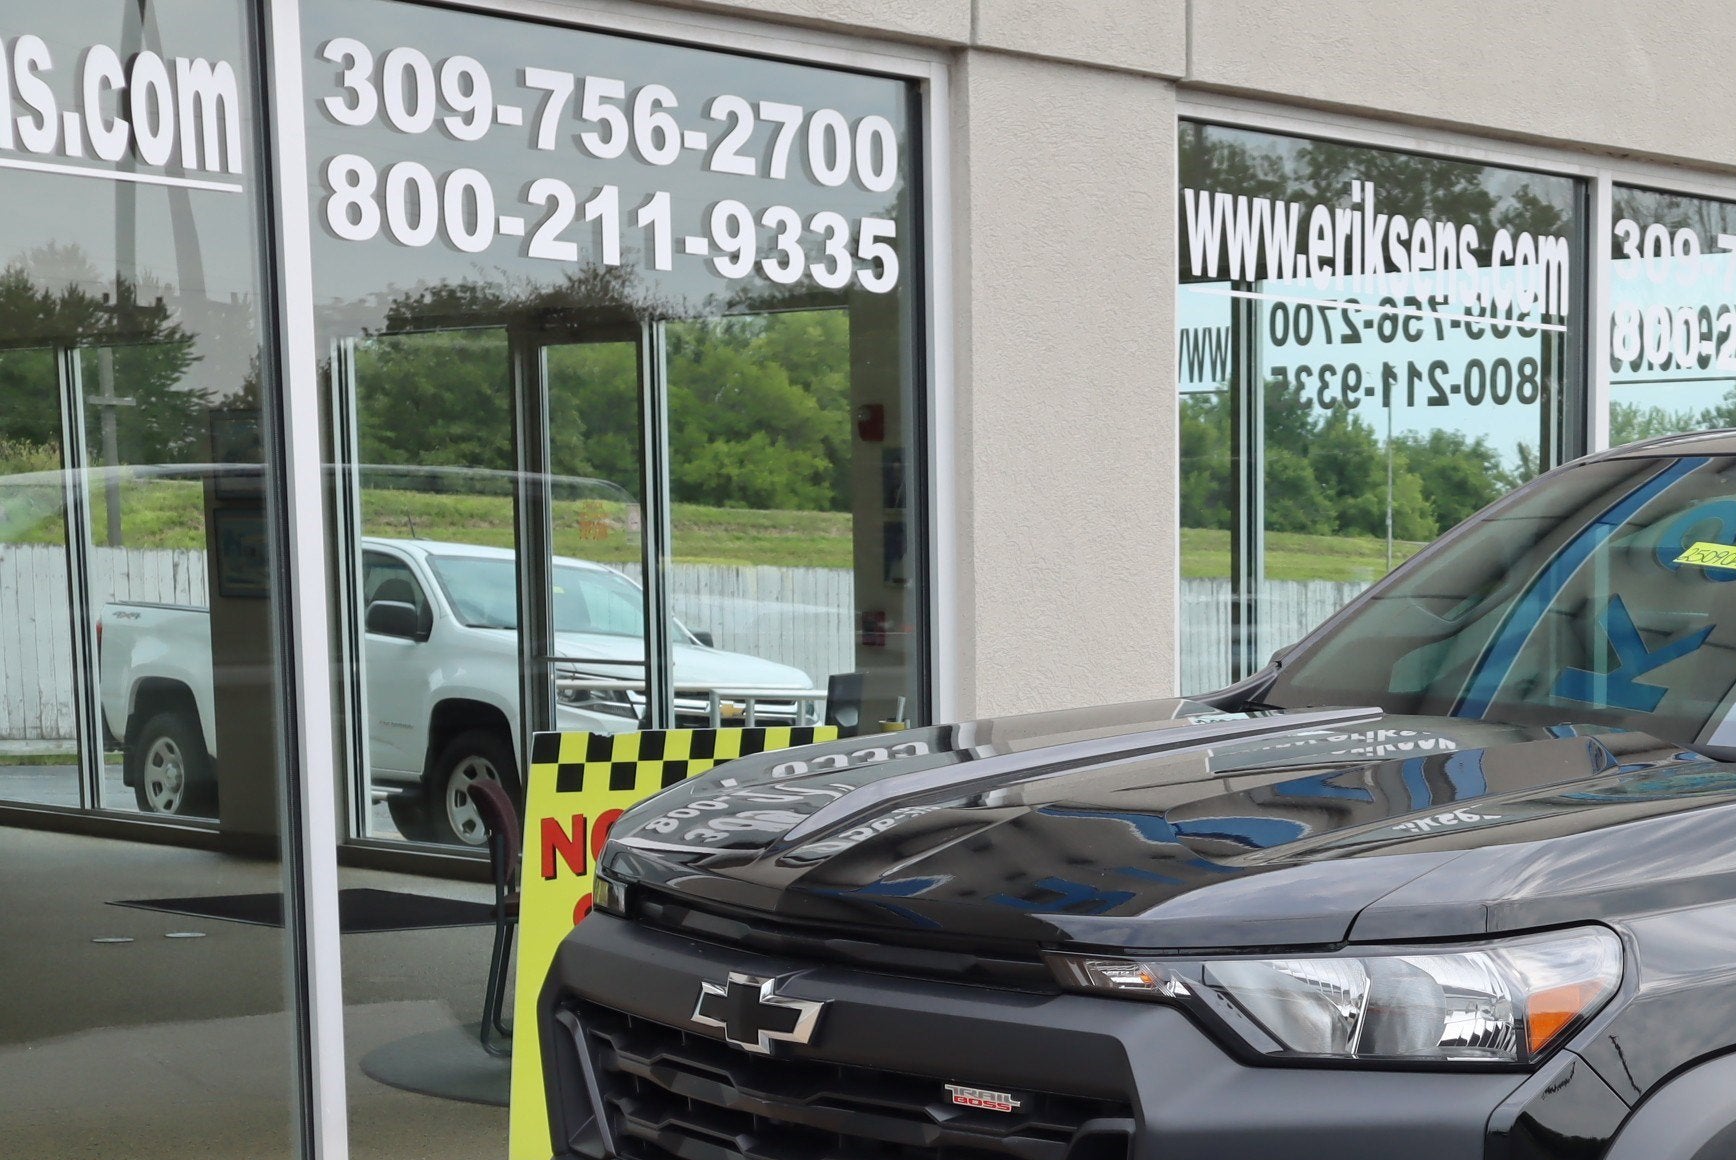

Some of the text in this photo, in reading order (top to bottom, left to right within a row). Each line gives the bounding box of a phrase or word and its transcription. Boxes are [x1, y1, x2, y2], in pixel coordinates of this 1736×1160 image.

[0, 34, 243, 175] s.com
[322, 37, 899, 193] 309-756-2700
[325, 153, 900, 294] 800-211-9335
[1183, 179, 1570, 317] www.eriksens.com
[944, 1083, 1021, 1108] TRAIL
[952, 1095, 1012, 1112] BOSS
